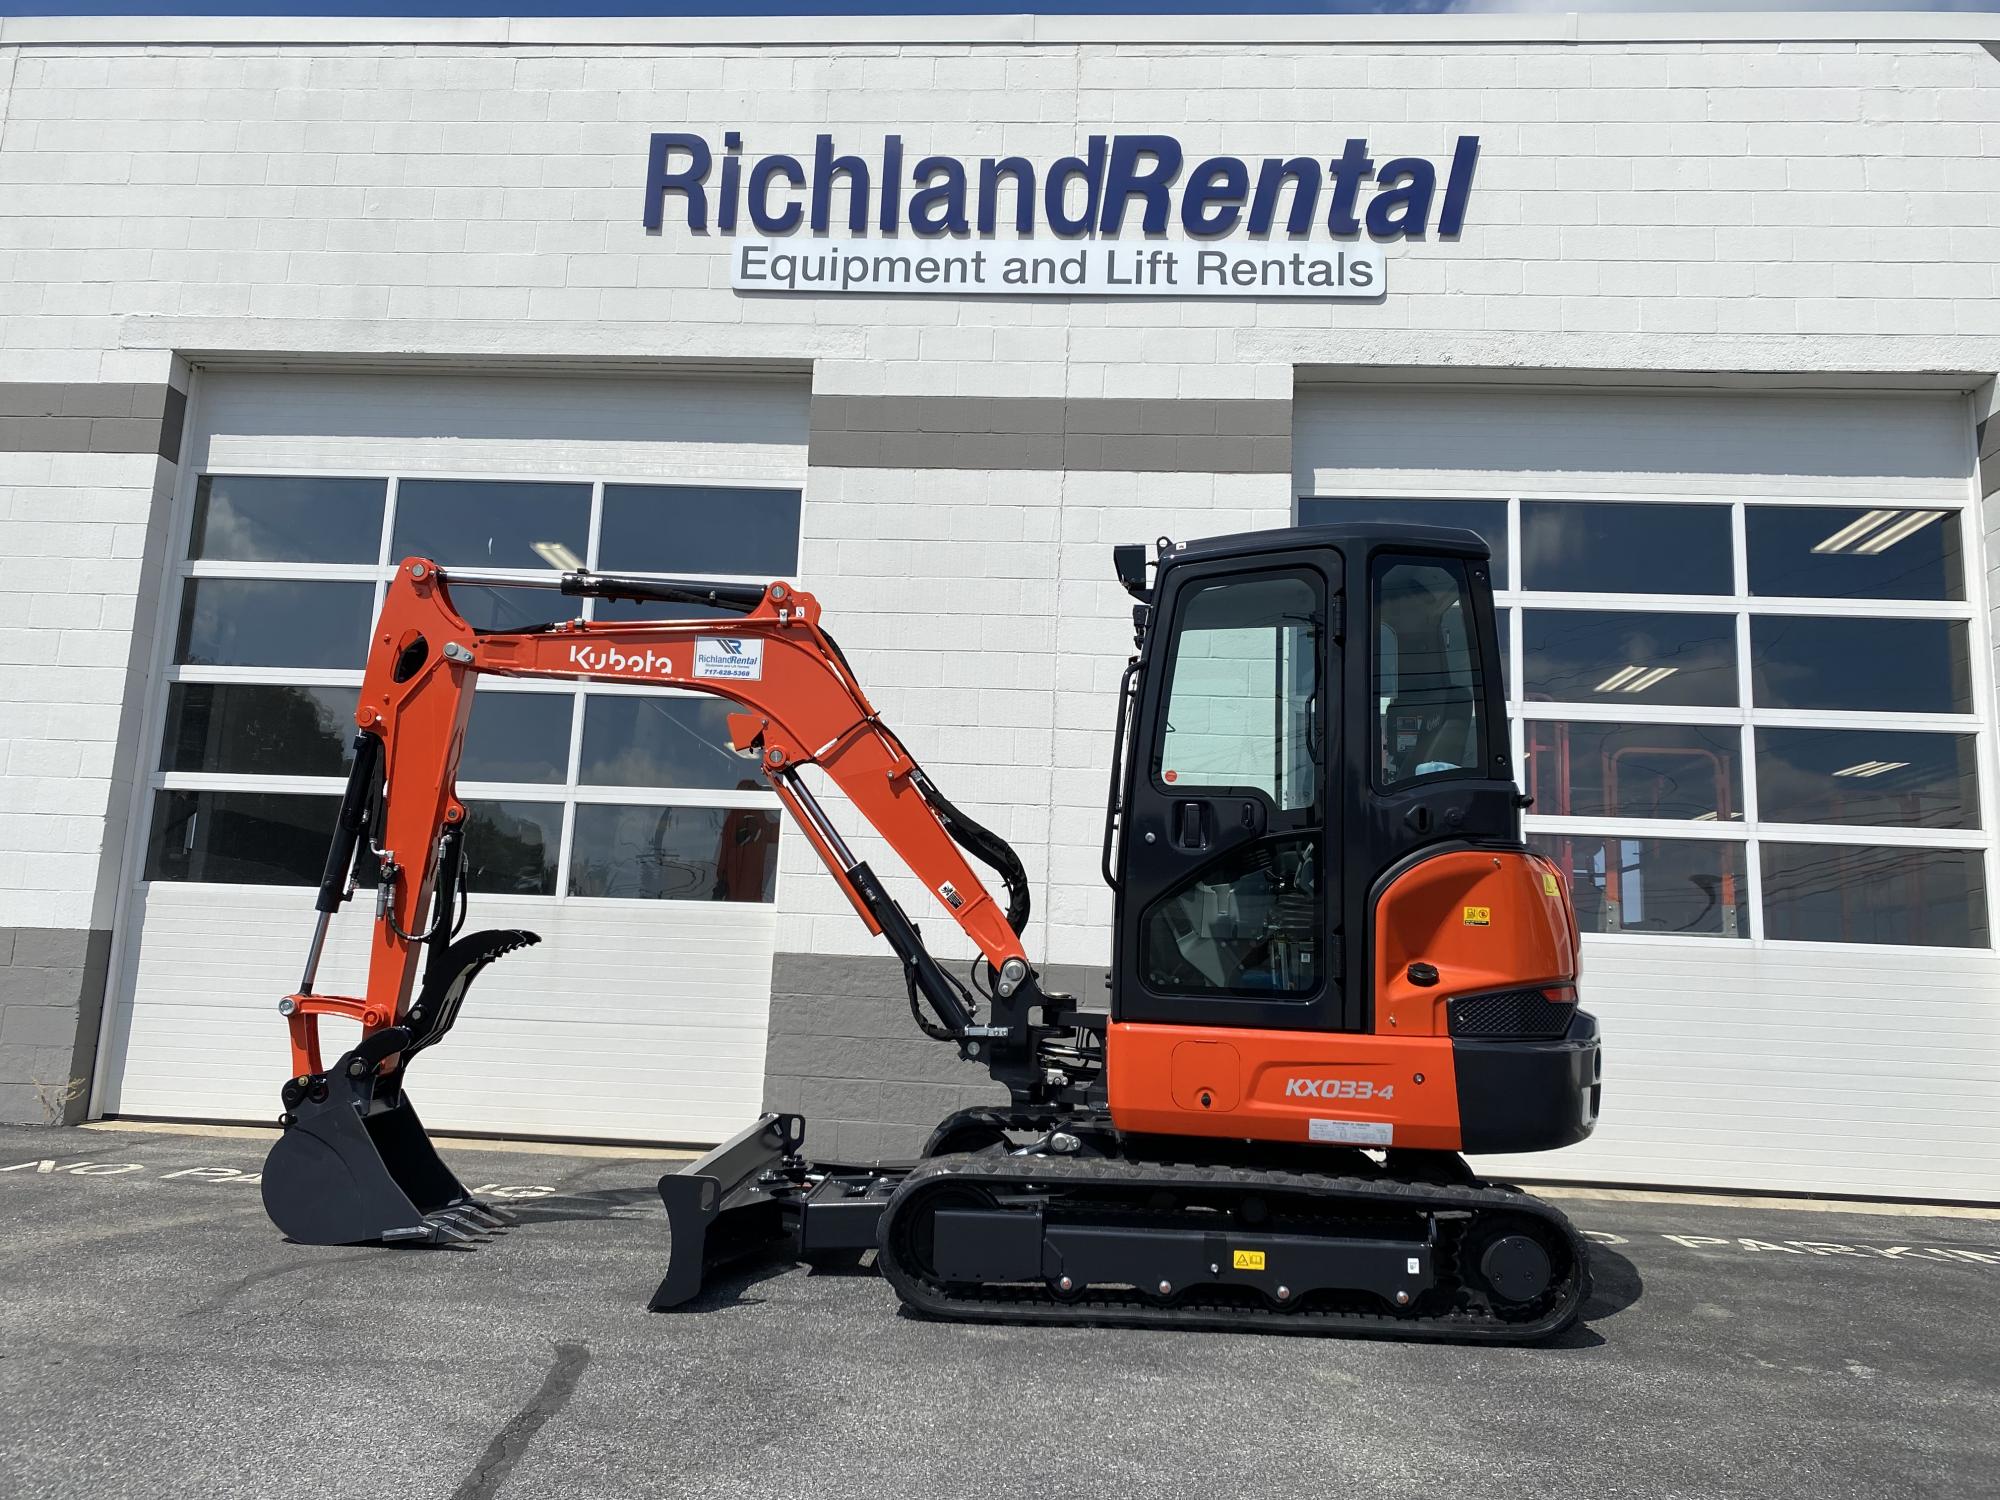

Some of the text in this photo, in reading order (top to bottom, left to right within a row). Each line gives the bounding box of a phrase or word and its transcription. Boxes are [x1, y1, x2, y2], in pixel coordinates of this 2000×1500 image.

[643, 131, 1480, 236] RichlandRental
[740, 245, 1374, 290] Equipment and Lift Rentals
[569, 645, 673, 674] Kubota
[1285, 1078, 1394, 1100] KX033-4
